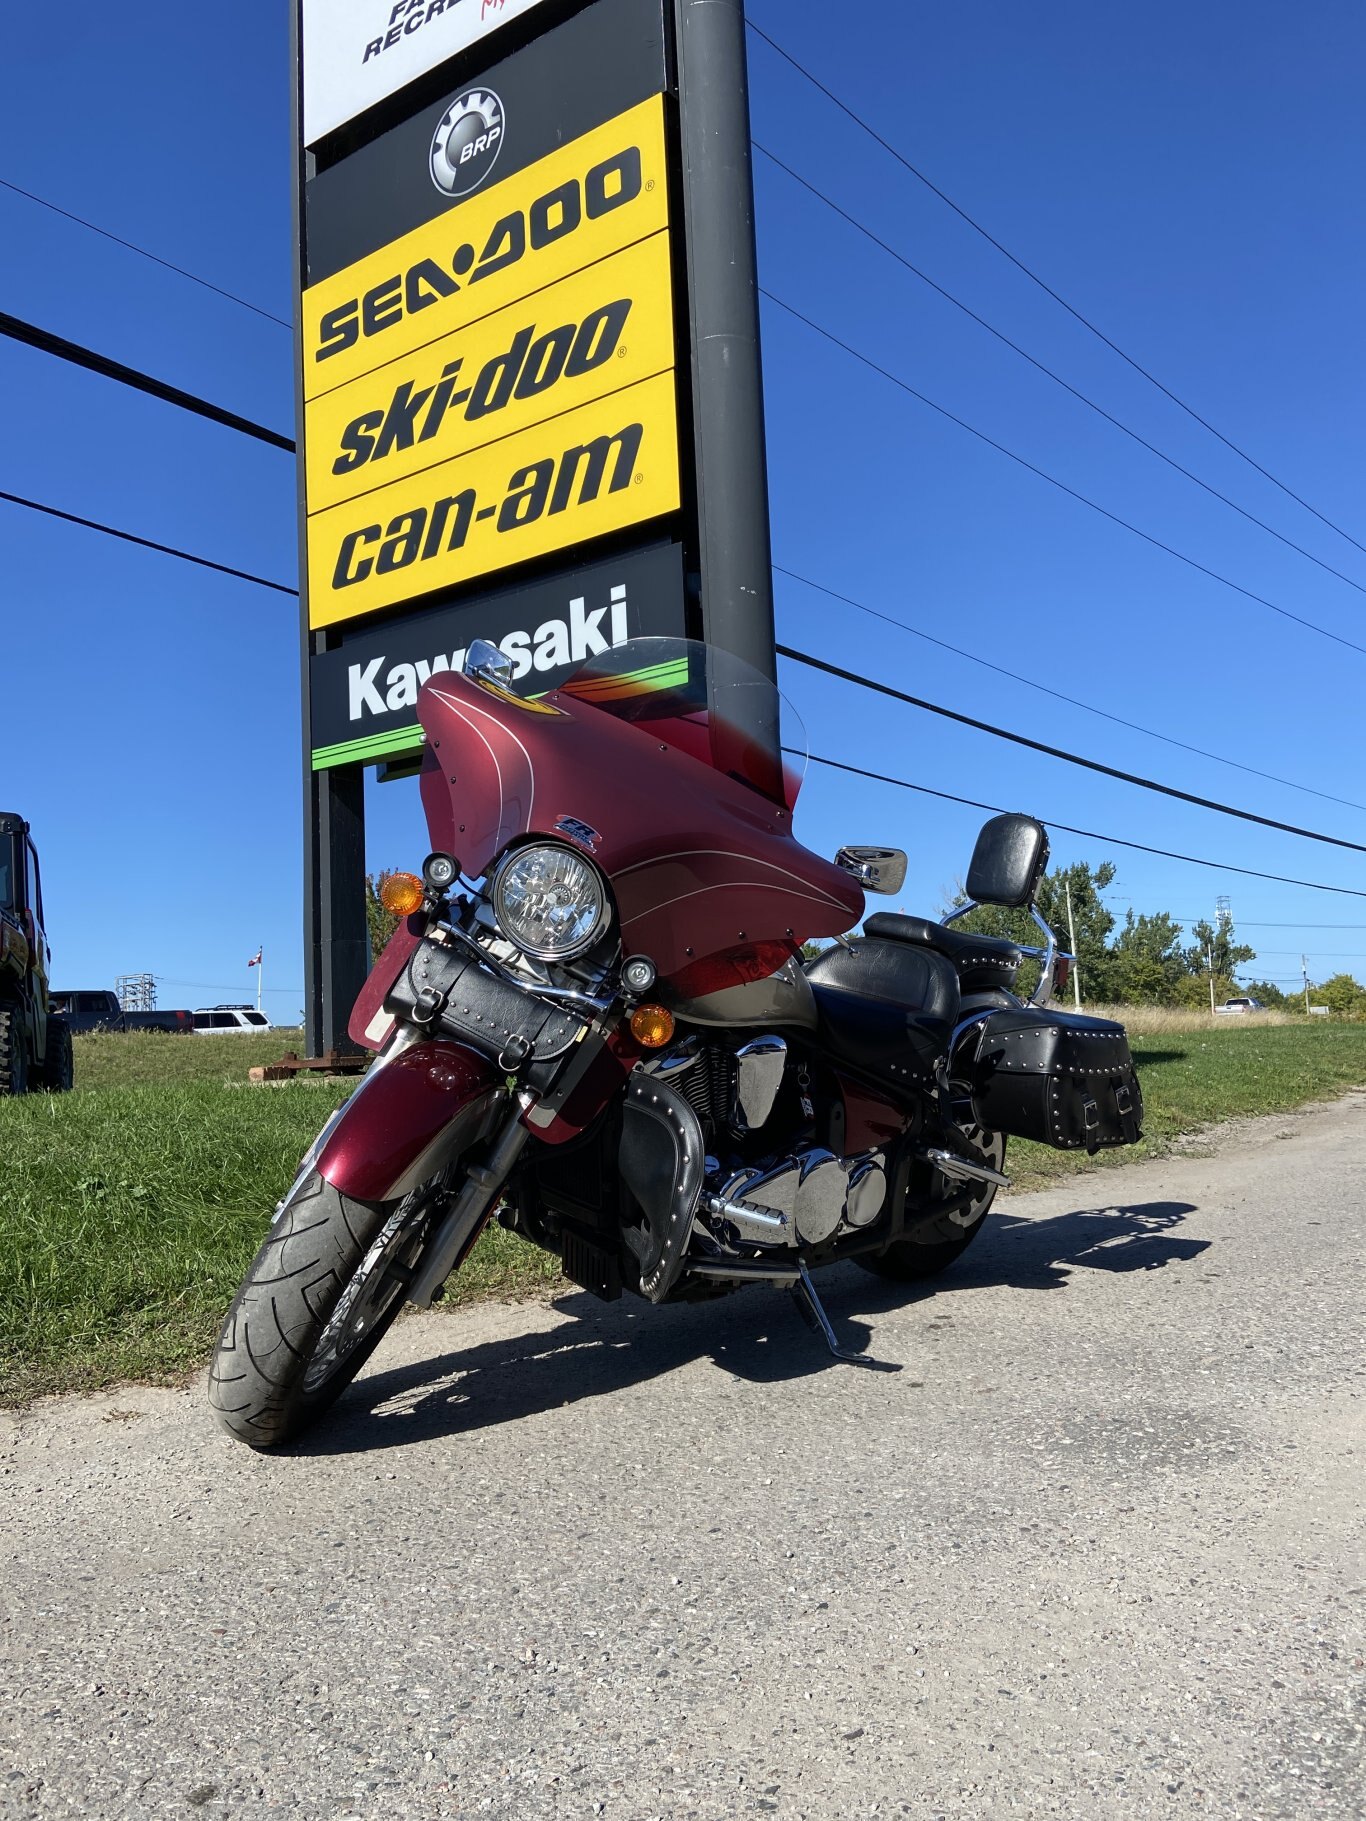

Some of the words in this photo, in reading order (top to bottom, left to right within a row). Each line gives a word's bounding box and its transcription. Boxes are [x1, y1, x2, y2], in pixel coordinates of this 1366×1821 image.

[459, 126, 501, 165] BRP
[331, 298, 633, 476] ski-doo
[331, 422, 644, 590] can-am
[348, 583, 628, 721] Kawsaki
